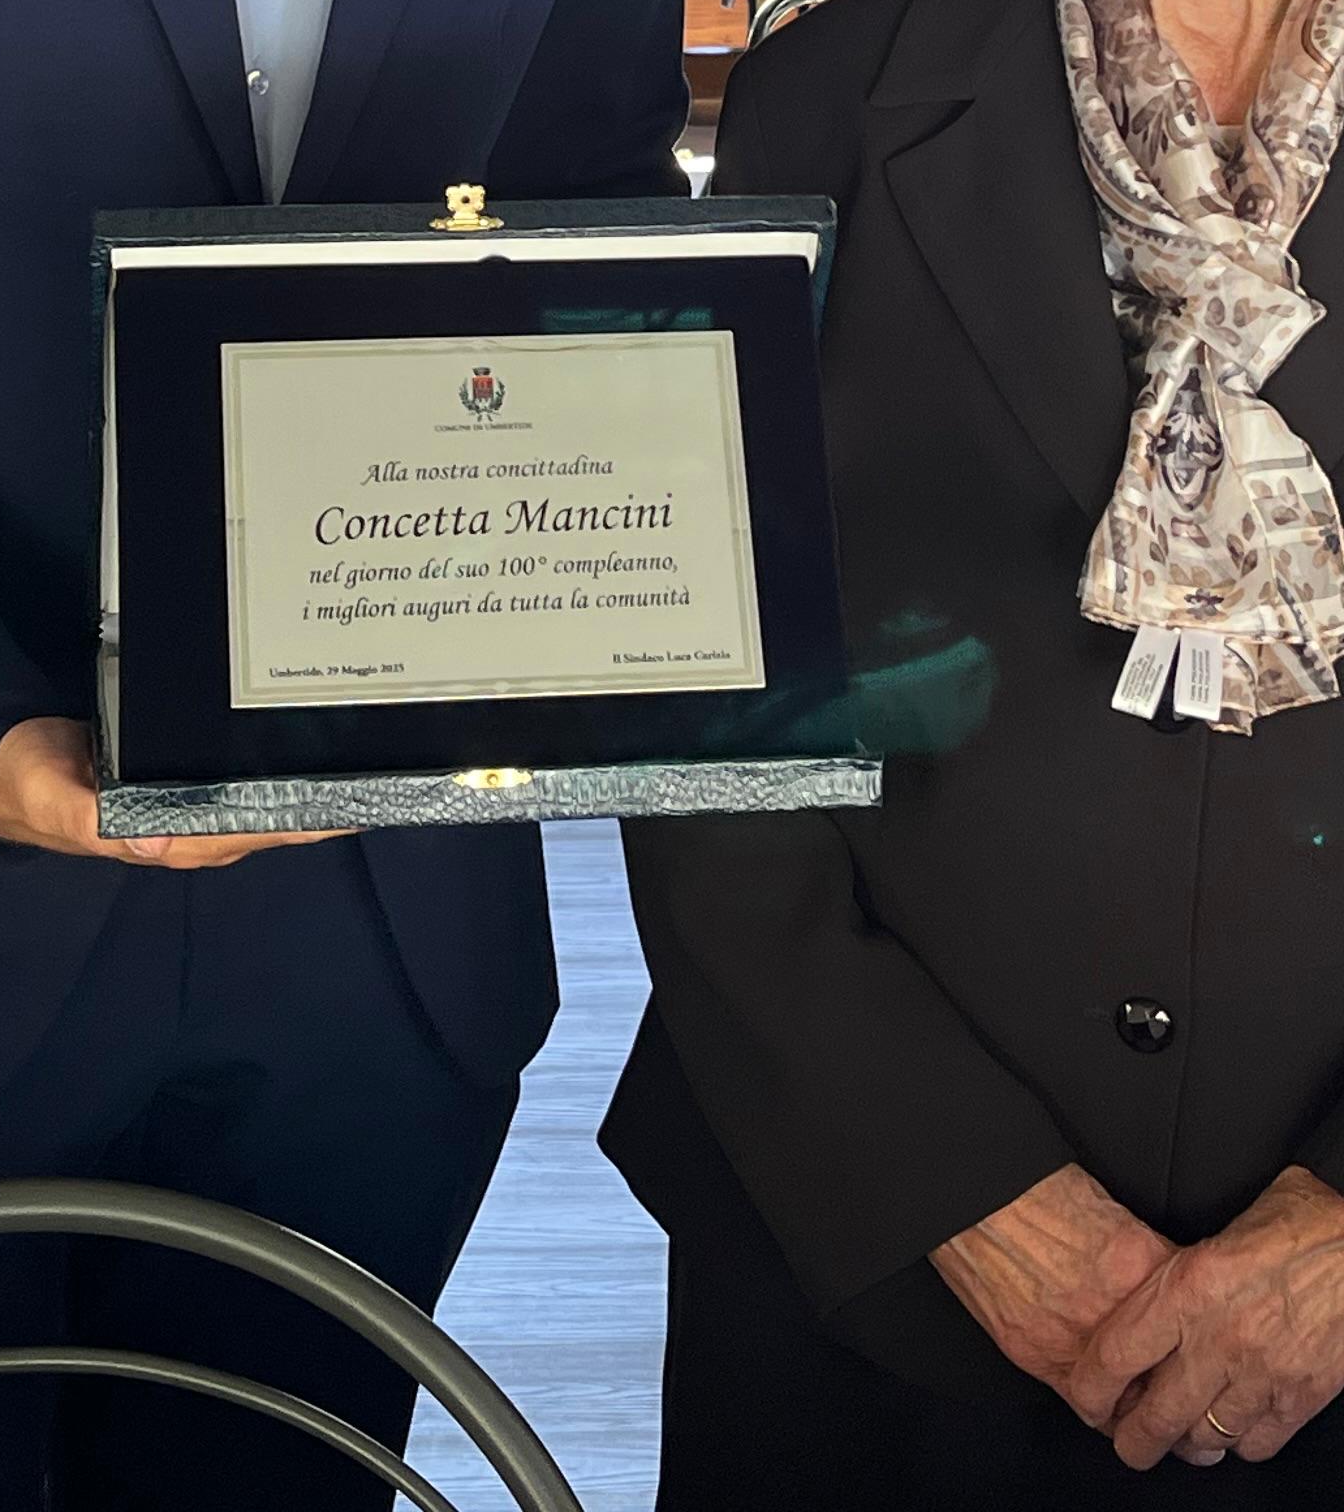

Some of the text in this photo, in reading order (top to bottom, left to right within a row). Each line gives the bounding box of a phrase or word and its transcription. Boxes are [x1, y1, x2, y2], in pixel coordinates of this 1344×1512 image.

[359, 453, 613, 486] Alla nostra concittadina
[314, 492, 673, 546] Concetta Mancini
[309, 550, 678, 590] nel giorno del suo 100° compleanno,
[302, 585, 691, 627] i migliori auguri da tutta la comunità
[341, 664, 379, 678] Maggio
[612, 653, 623, 664] Il
[622, 651, 665, 664] Sindaco
[666, 650, 692, 662] Luca
